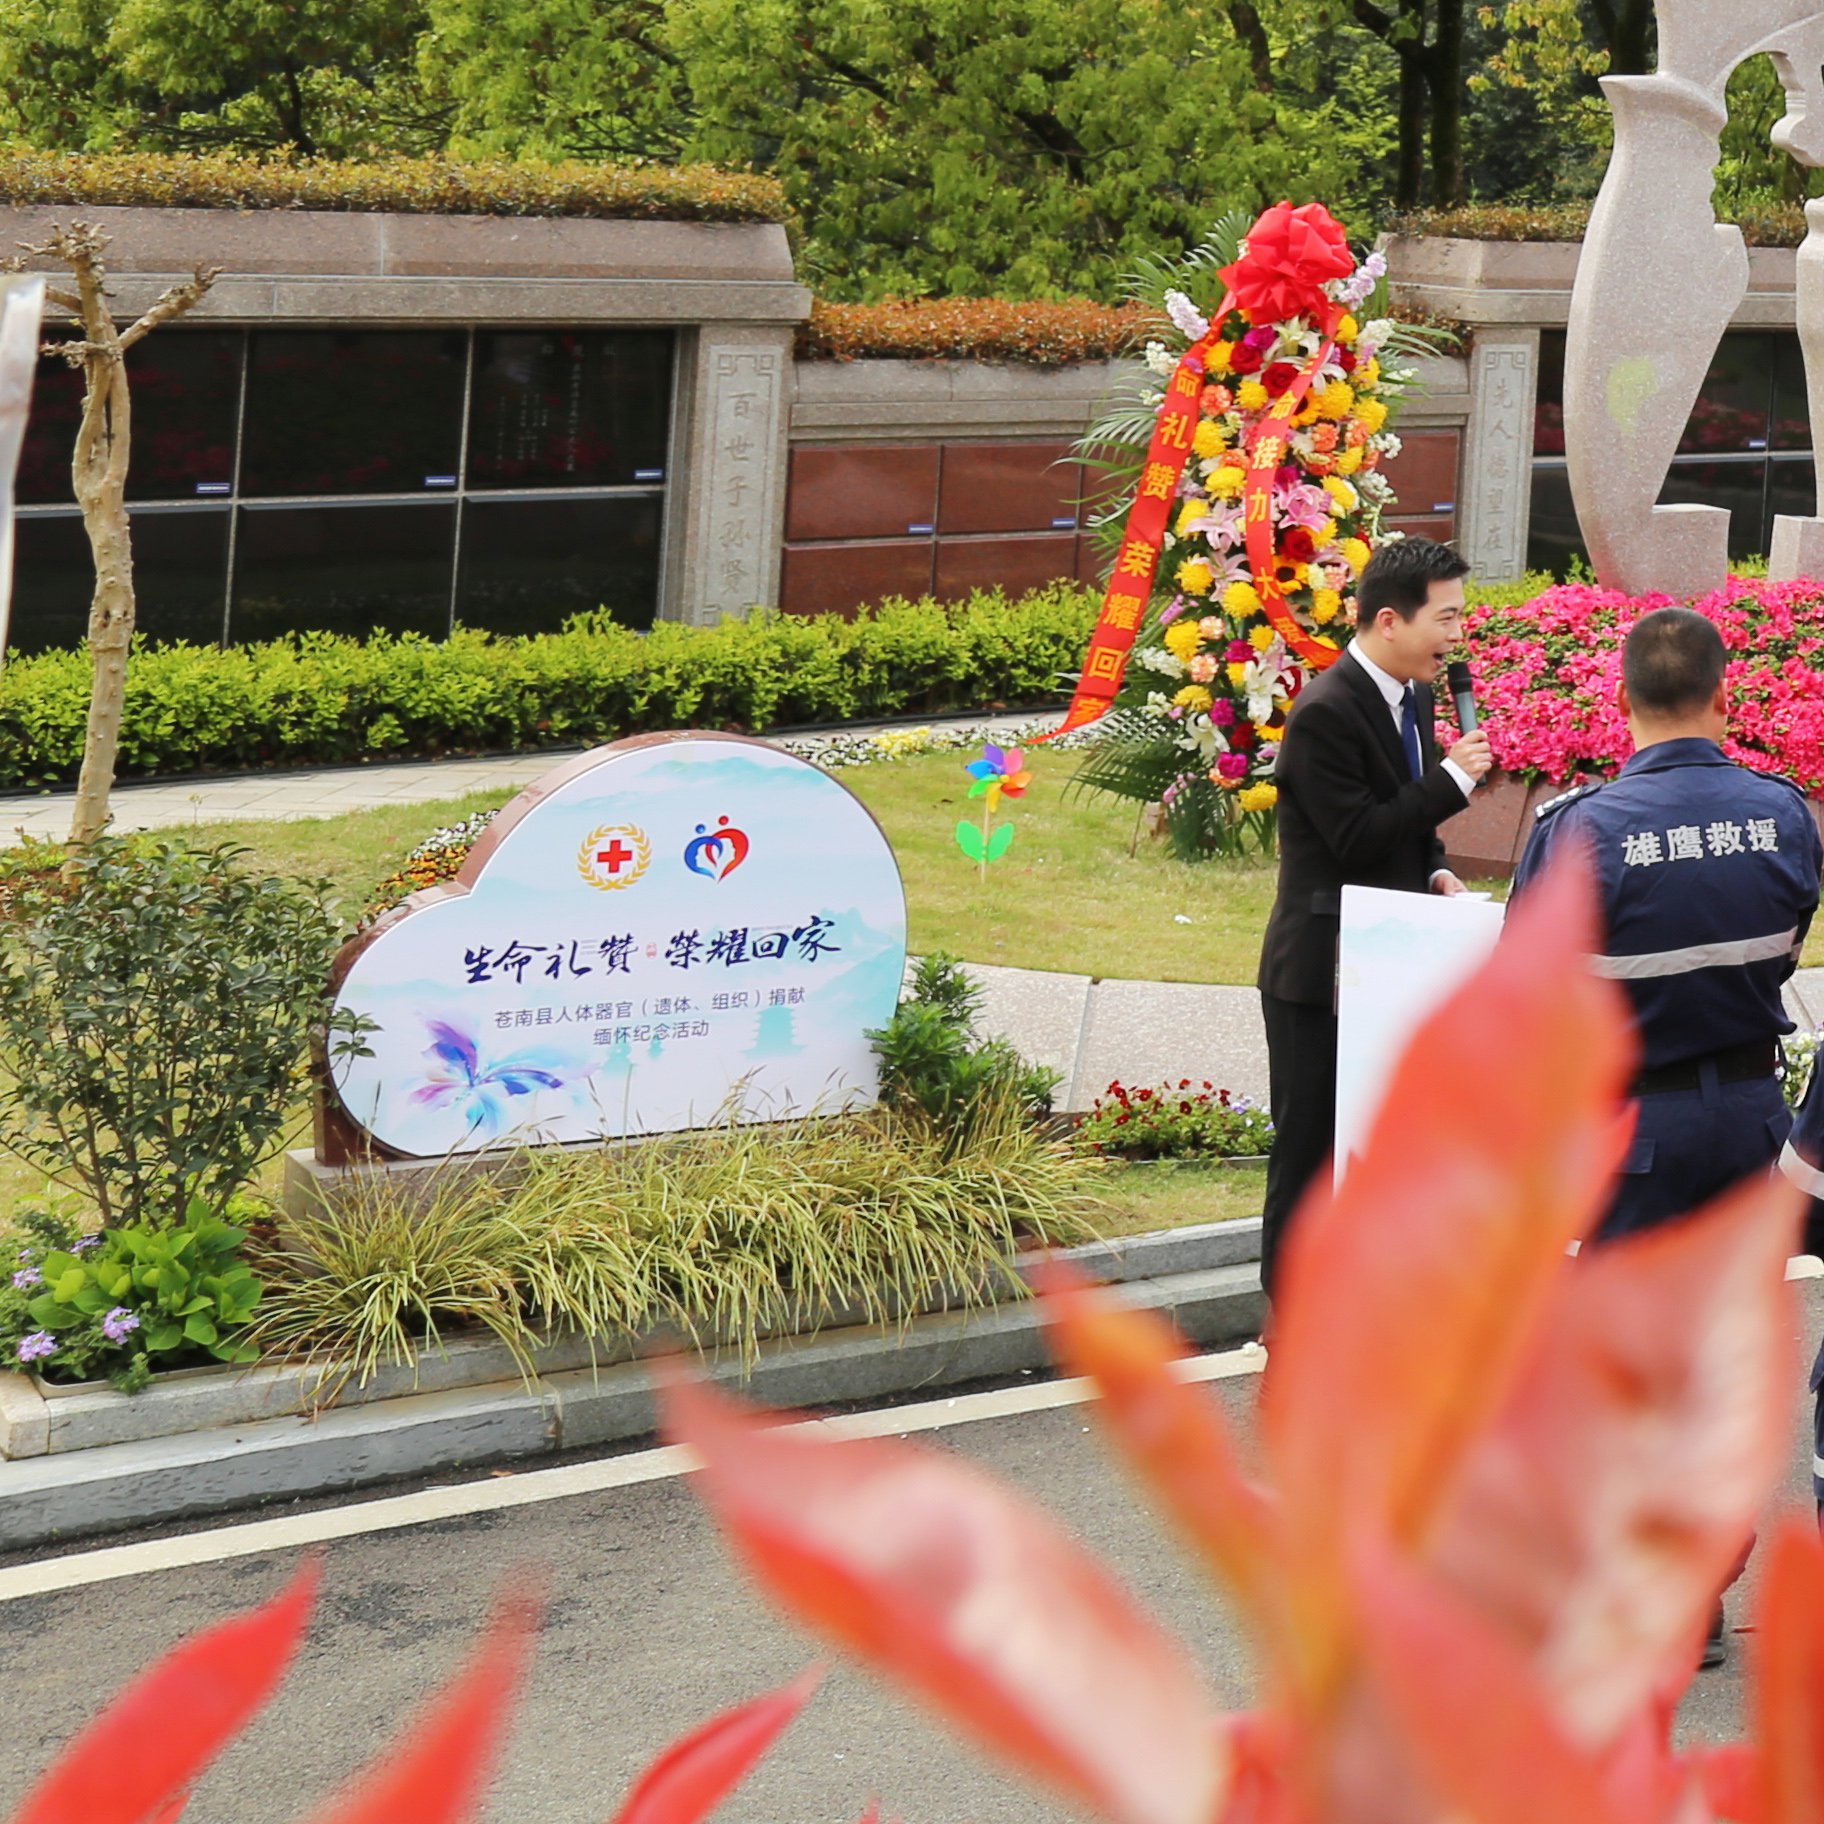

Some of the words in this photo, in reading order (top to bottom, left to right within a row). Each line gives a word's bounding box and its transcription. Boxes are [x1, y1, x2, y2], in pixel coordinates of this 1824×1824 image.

[1621, 817, 1779, 867] 雄鹰救援
[593, 1019, 710, 1047] 缅怀纪念活动
